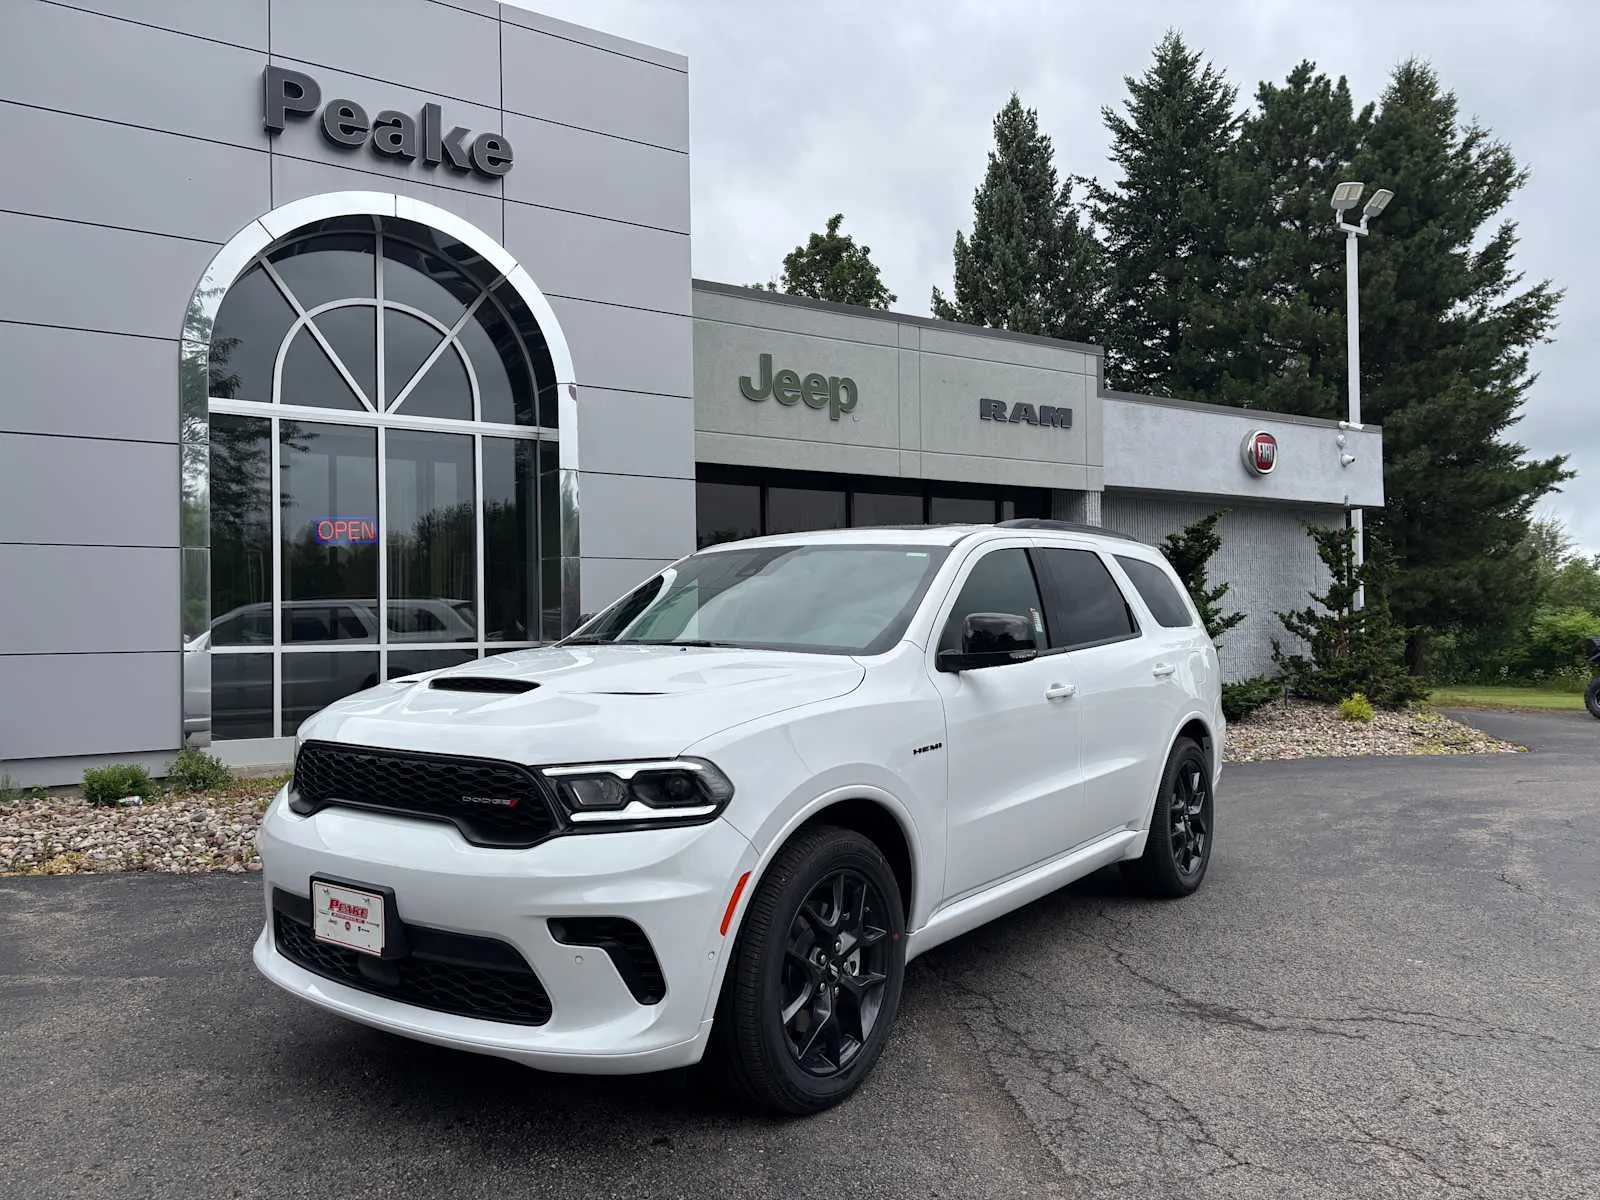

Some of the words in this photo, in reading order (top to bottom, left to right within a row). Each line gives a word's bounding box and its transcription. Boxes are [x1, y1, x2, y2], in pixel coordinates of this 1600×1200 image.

[264, 65, 514, 178] Peake
[739, 353, 858, 421] Jeep
[980, 398, 1073, 429] RAM
[318, 519, 375, 543] OPEN
[912, 742, 943, 755] HEMI
[462, 795, 511, 805] DODGE
